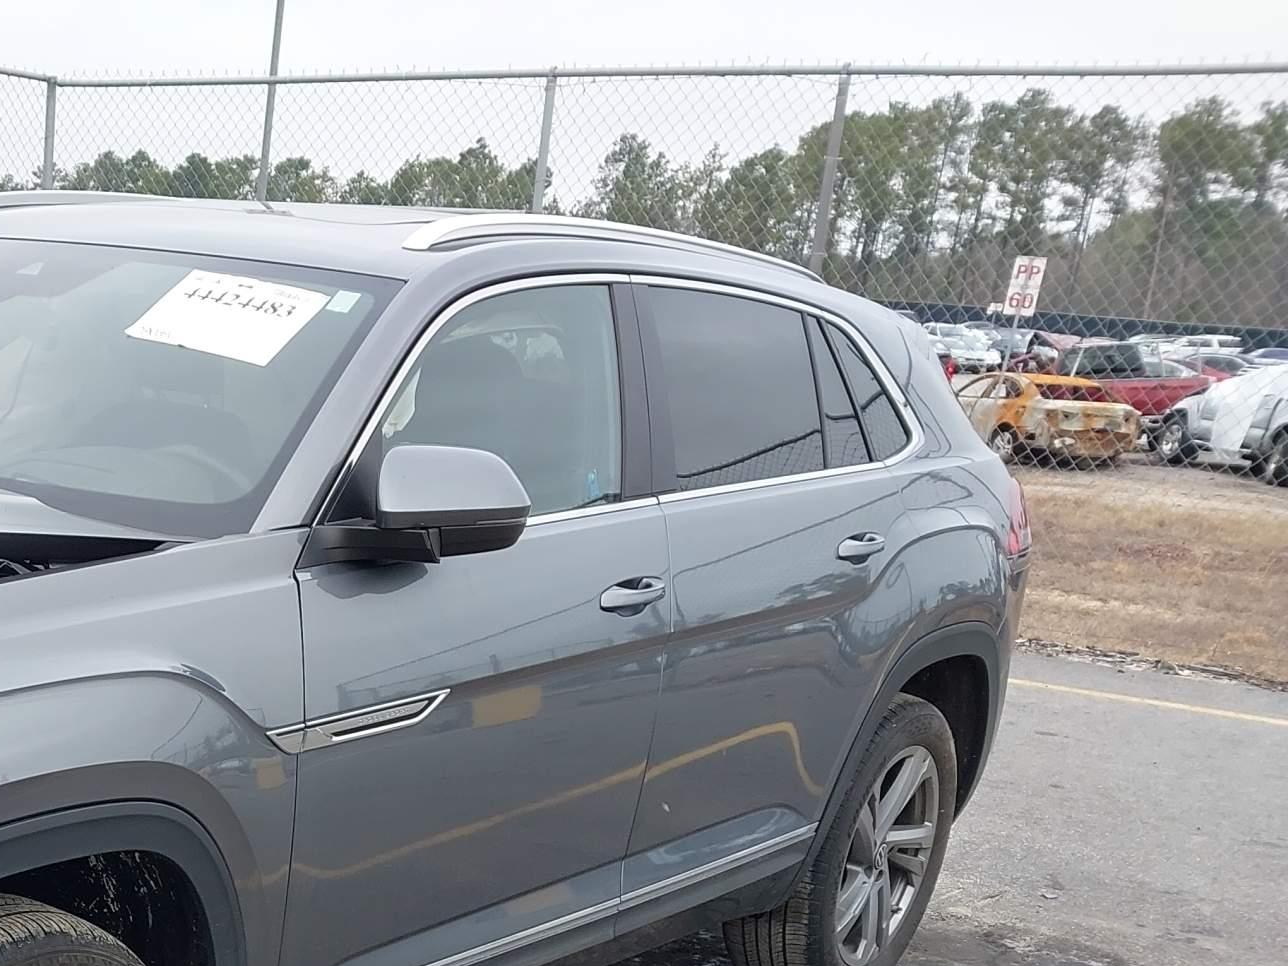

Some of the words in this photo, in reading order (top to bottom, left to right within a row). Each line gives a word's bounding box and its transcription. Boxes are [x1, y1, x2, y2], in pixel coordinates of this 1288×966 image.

[1015, 264, 1041, 280] PP
[184, 287, 296, 318] 44424483
[1009, 292, 1034, 309] 60
